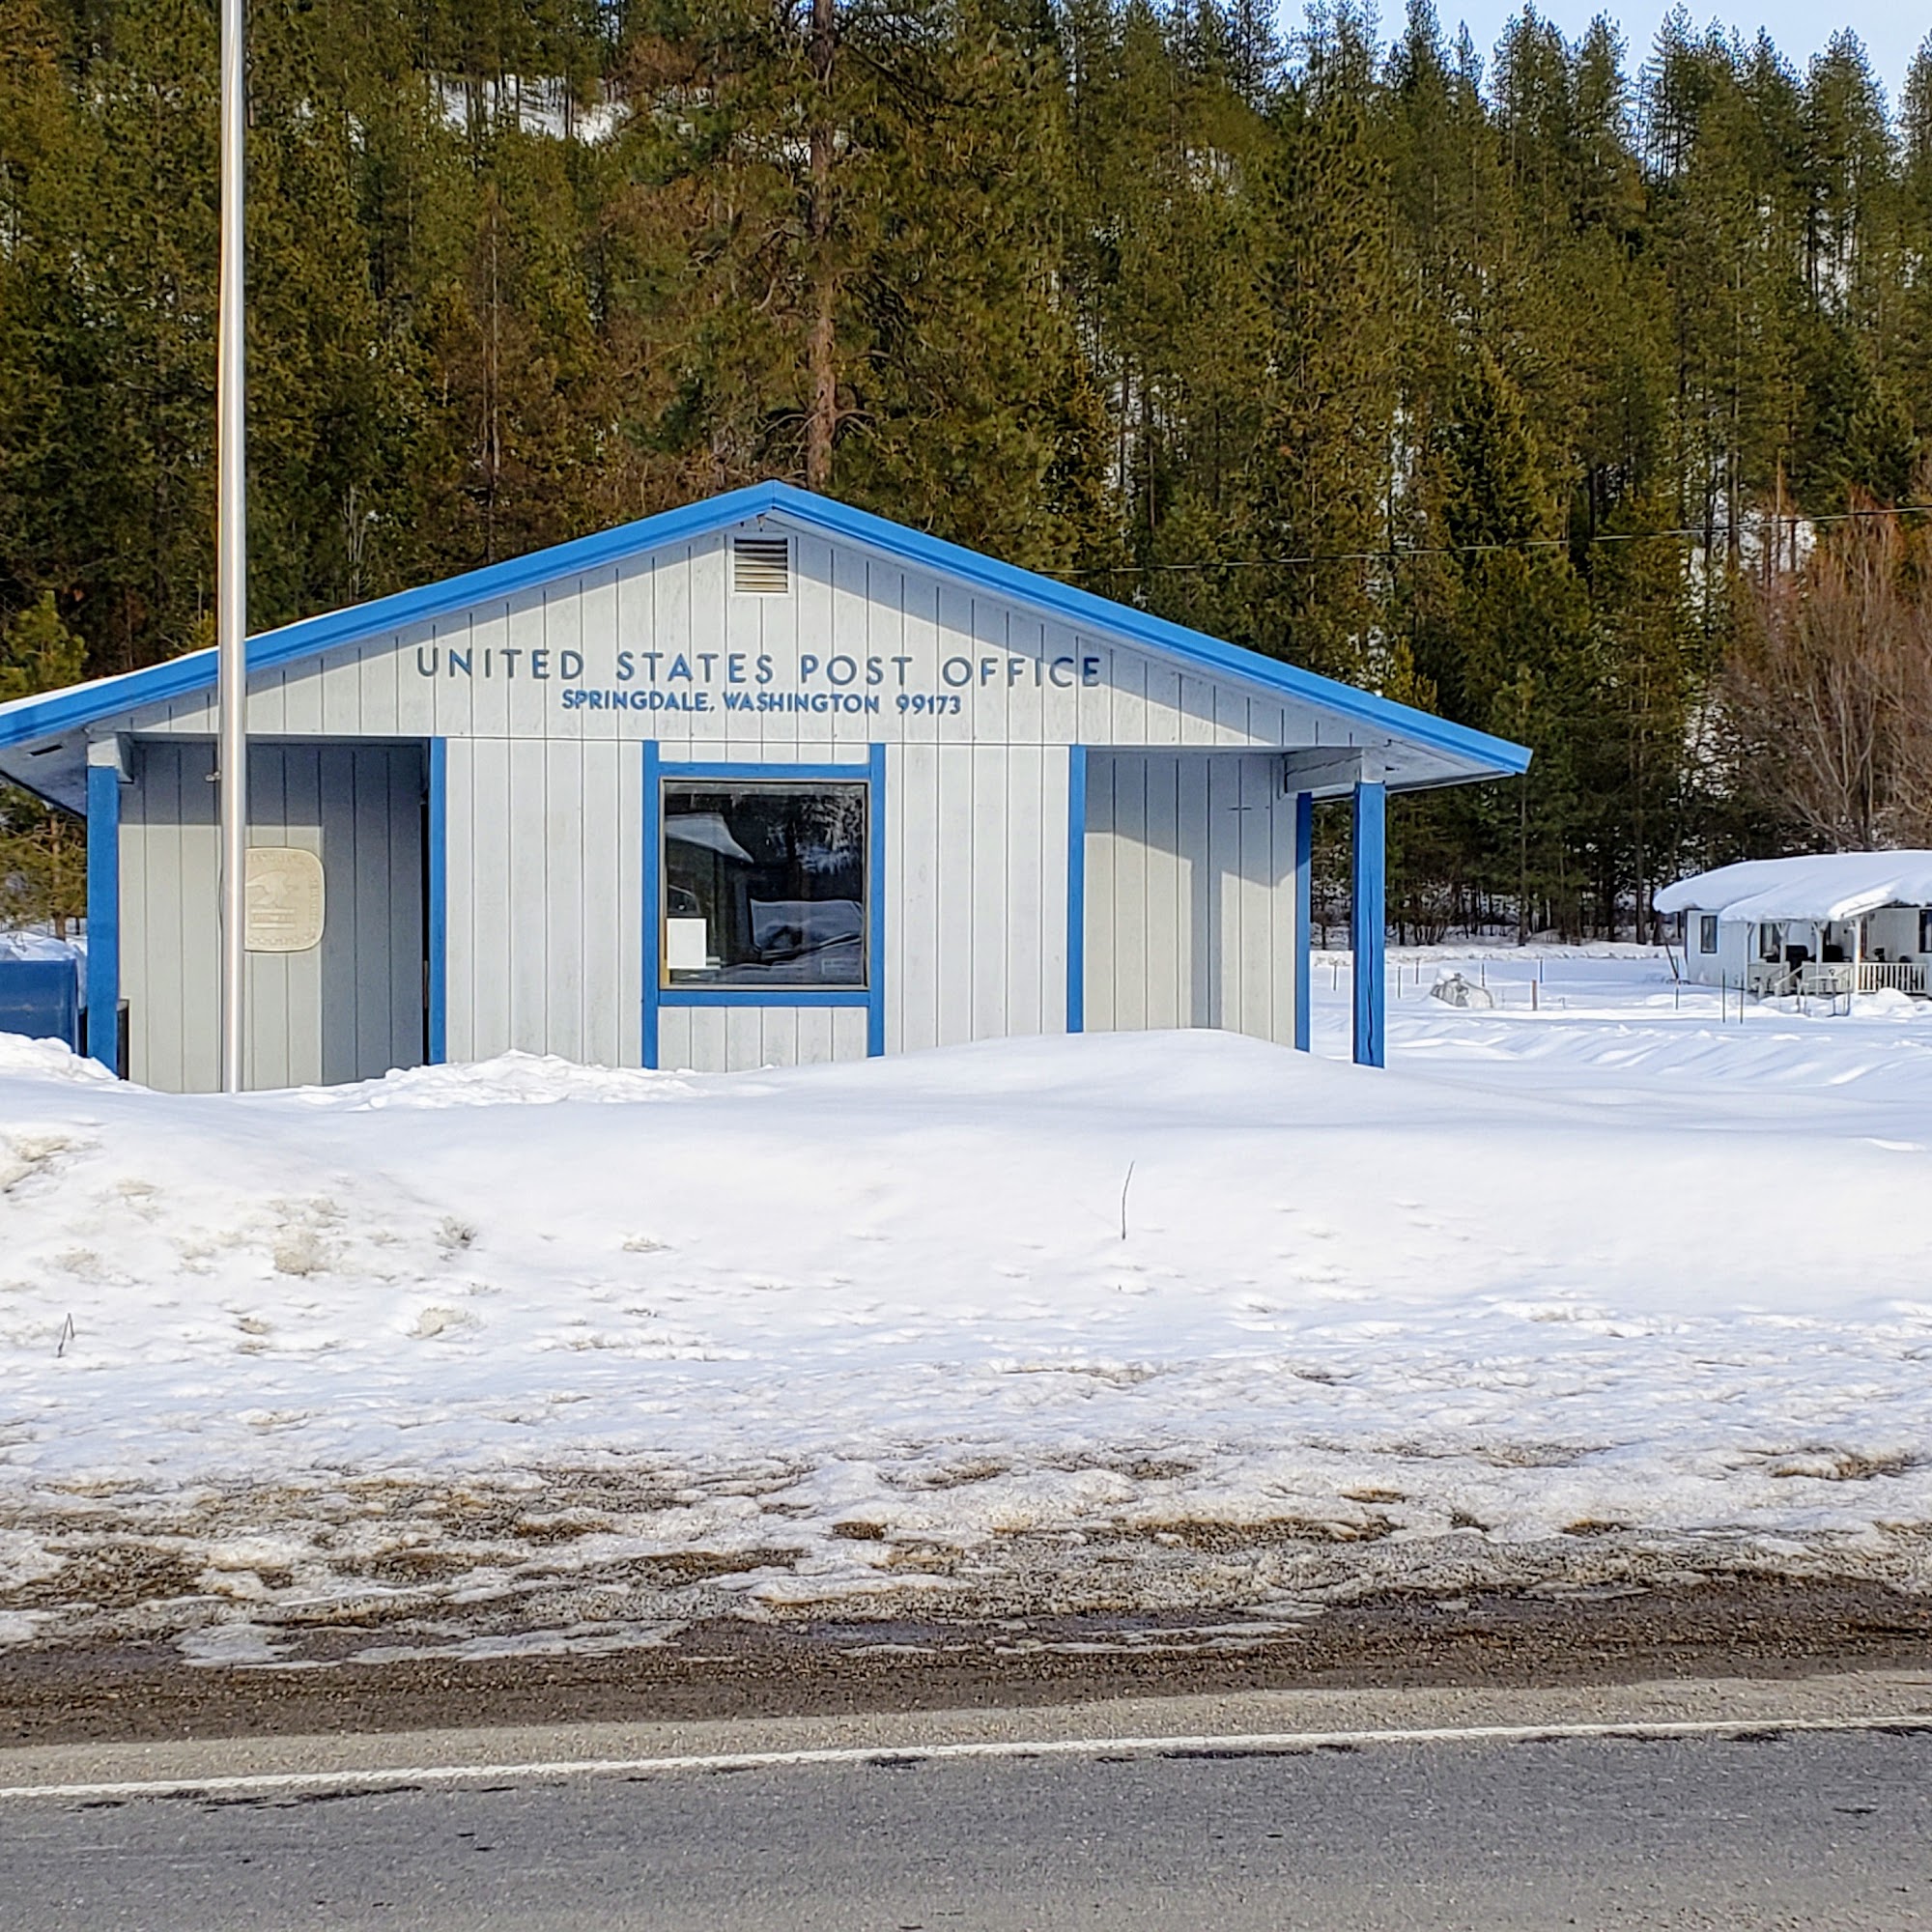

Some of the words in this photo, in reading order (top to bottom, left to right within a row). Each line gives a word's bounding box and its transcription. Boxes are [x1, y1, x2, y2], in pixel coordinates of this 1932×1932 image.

[417, 647, 584, 679] UNITED
[616, 651, 773, 684] STATES
[801, 654, 913, 687] POST
[942, 657, 1100, 688] OFFICE
[722, 691, 880, 715] WASHINGTON
[895, 694, 962, 715] 99173
